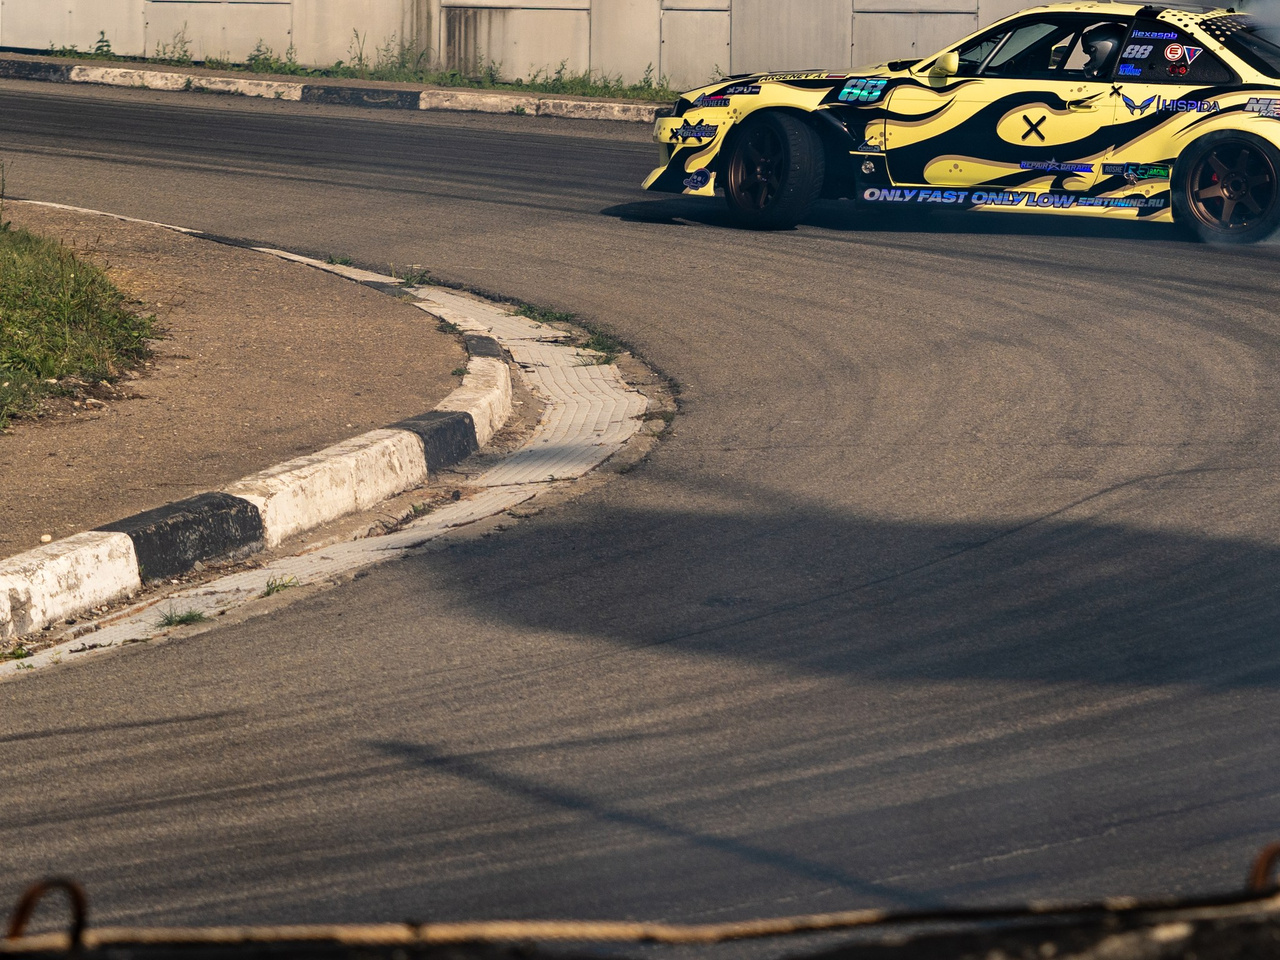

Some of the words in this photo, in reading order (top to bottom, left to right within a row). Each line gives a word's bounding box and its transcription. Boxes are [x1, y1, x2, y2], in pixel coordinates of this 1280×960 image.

[1122, 45, 1153, 59] 88
[838, 78, 888, 101] 88
[702, 99, 730, 107] WHEELS
[1162, 99, 1220, 113] HISPIDA
[1020, 160, 1048, 170] REPAIR
[1060, 163, 1092, 173] GARAGE
[1104, 165, 1123, 173] ROSHE
[863, 188, 916, 201] ONLY
[916, 190, 967, 203] FAST
[971, 191, 1027, 205] ONLY
[1026, 191, 1076, 208] LOW
